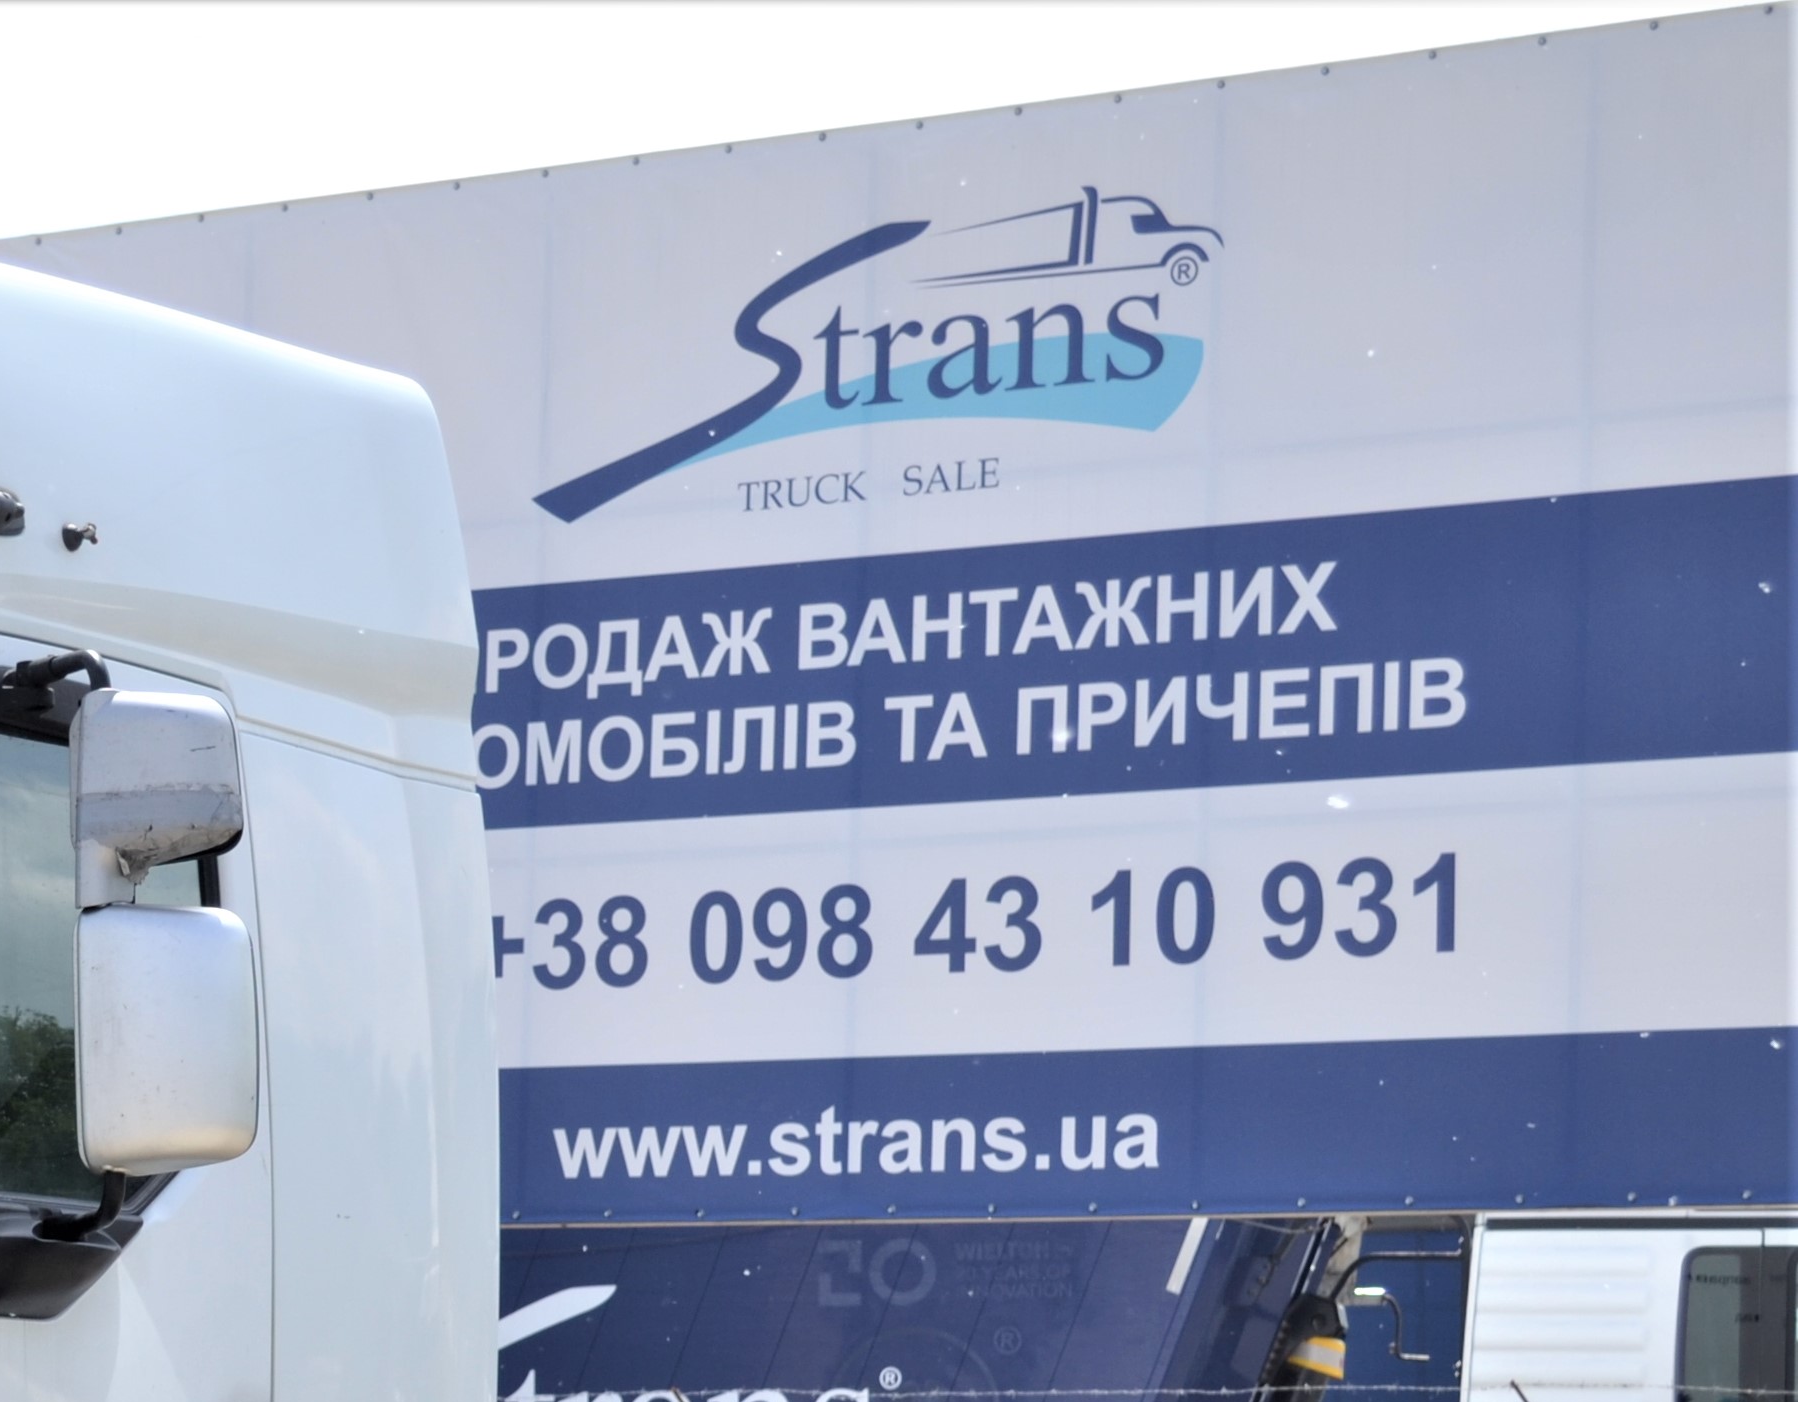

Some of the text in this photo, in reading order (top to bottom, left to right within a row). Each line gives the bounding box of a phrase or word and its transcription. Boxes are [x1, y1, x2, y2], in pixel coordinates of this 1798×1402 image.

[532, 220, 1166, 524] Strans
[737, 457, 1001, 514] TRUCK SALE
[484, 560, 1339, 700] РОДАЖ ВАНТАЖНИХ
[473, 656, 1468, 790] ОМОБІЛІВ ТА ПРИЧЕПІВ
[491, 851, 1458, 991] +38 098 43 10 931
[552, 1104, 1160, 1179] www.strans.ua
